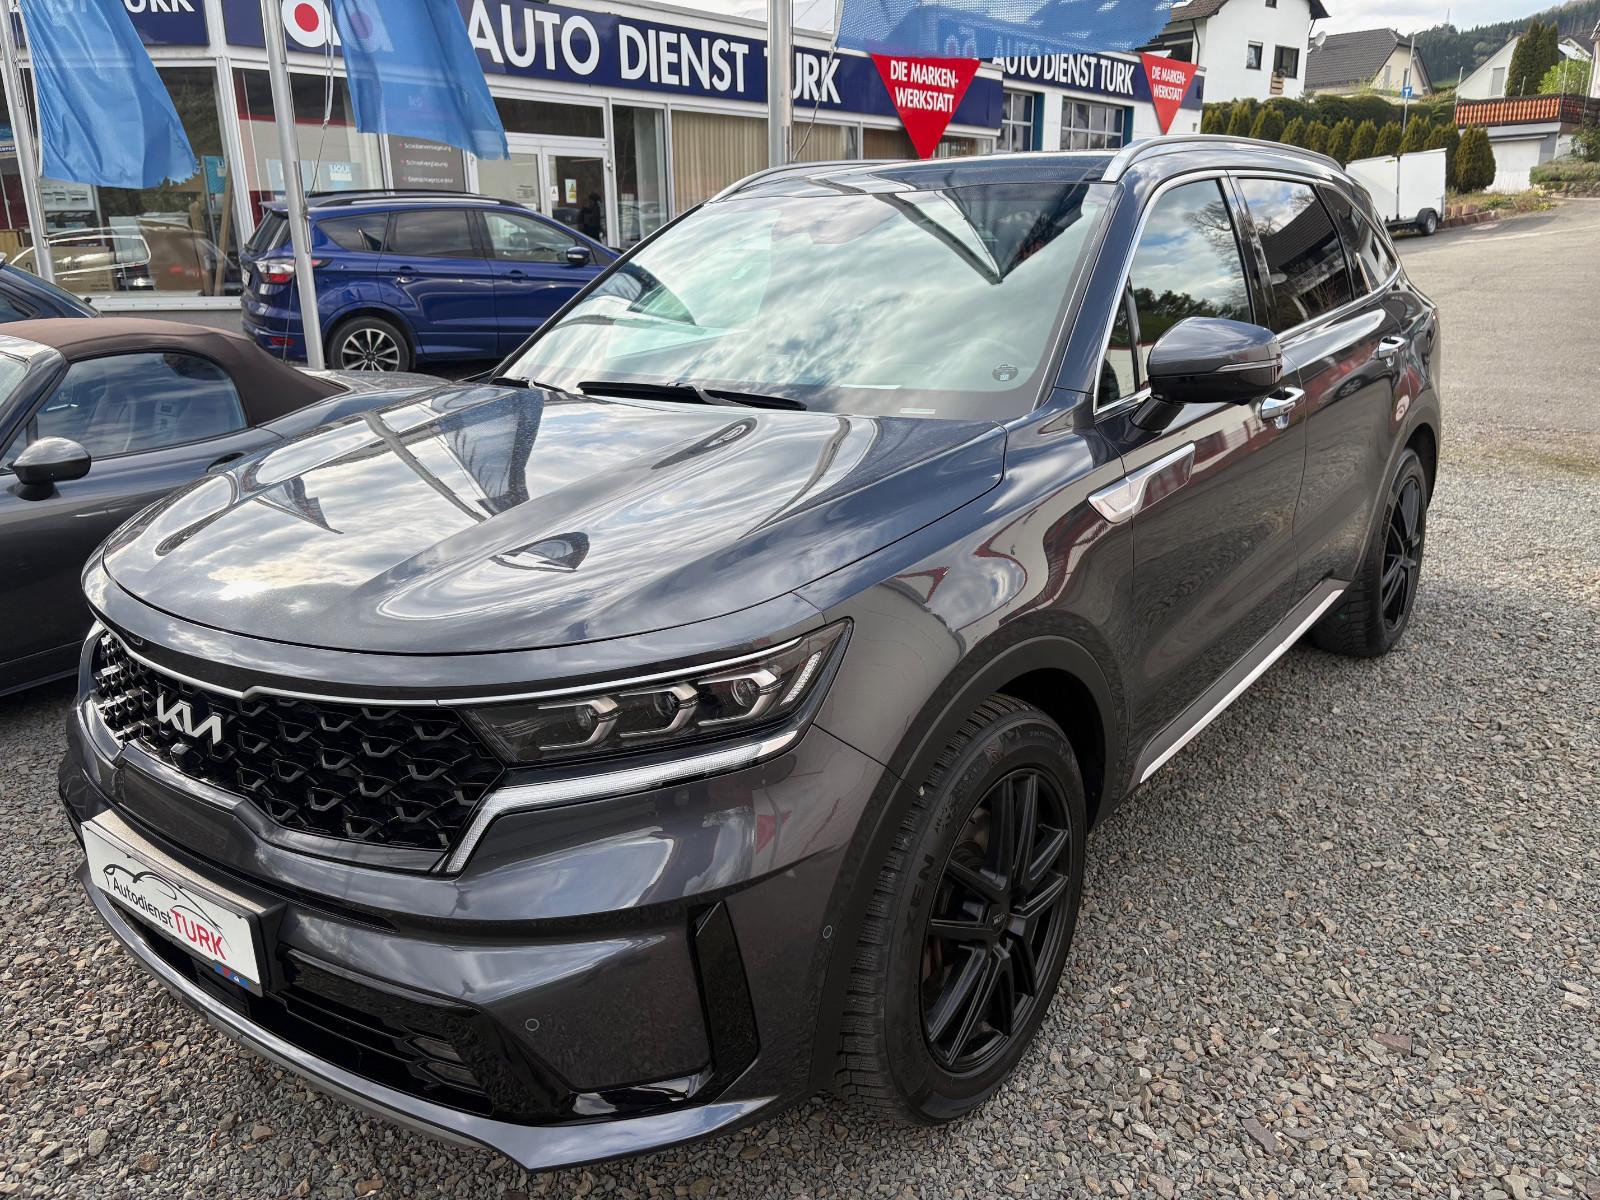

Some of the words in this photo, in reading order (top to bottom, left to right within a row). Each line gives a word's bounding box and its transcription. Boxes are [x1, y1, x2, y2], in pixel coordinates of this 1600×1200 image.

[467, 0, 600, 76] AUTO
[618, 24, 749, 93] DIENST
[764, 47, 842, 104] URK
[890, 60, 908, 81] DIE
[910, 62, 959, 89] MARKEN-
[1043, 53, 1096, 88] DIENST
[1100, 59, 1135, 95] TURK
[1151, 66, 1161, 80] DIE
[1161, 67, 1186, 86] MARKEN-
[894, 86, 954, 112] WERKSTATT
[1153, 84, 1184, 102] WERKSTATT
